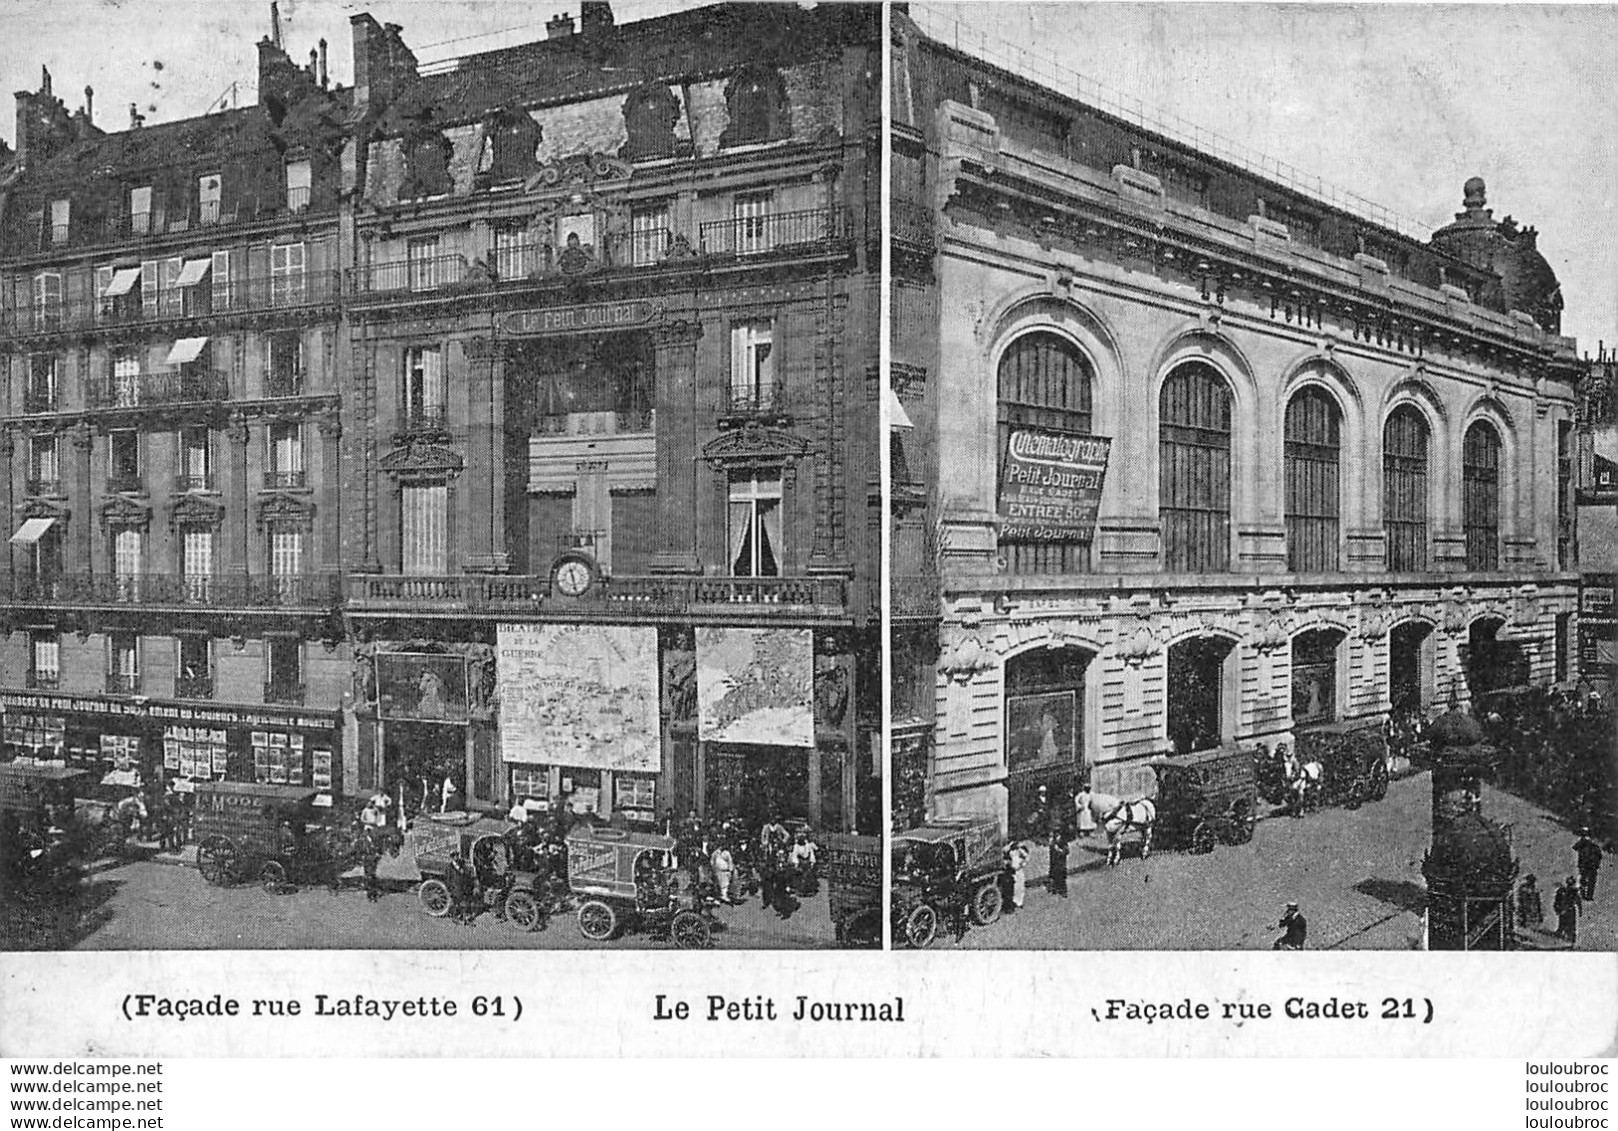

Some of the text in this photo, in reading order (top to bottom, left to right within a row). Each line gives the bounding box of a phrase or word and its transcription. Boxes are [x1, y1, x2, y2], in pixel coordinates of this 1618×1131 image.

[521, 304, 635, 331] Le Petit Journal
[1008, 463, 1101, 490] Petit Journal
[999, 523, 1092, 541] Petit Journal
[73, 700, 108, 713] Journal
[122, 994, 524, 1021] (Façade rue Lafayette 61)
[653, 994, 905, 1022] Le Petit Journal
[1222, 1003, 1272, 1019] rue
[1284, 997, 1369, 1019] Cadet
[1381, 997, 1434, 1024] 21)
